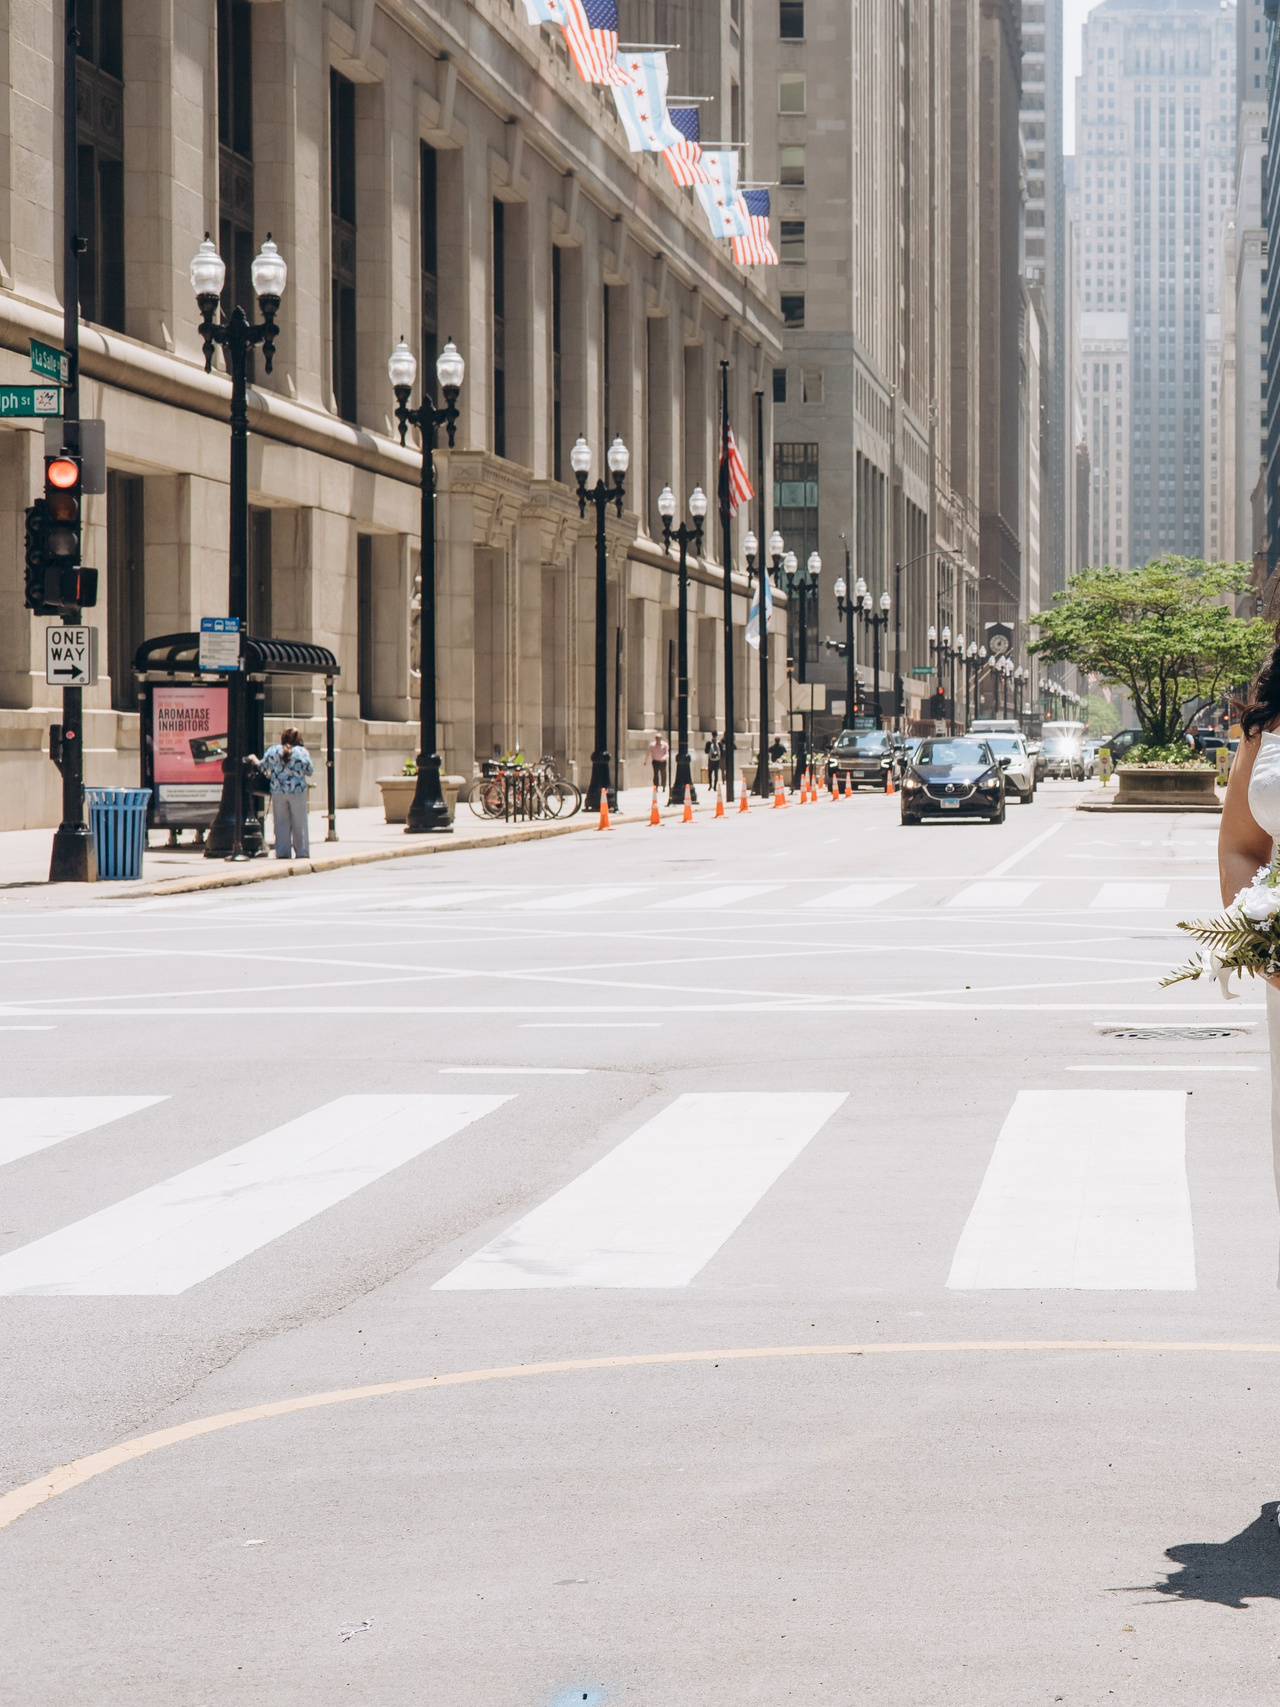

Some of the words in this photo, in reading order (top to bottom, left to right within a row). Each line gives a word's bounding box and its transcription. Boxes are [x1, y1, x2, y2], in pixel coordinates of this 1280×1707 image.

[43, 351, 57, 373] Salle
[21, 396, 31, 406] St
[51, 631, 85, 645] ONE
[51, 647, 85, 661] WAY
[158, 708, 210, 720] AROMATASE
[158, 720, 210, 732] INHIBITORS
